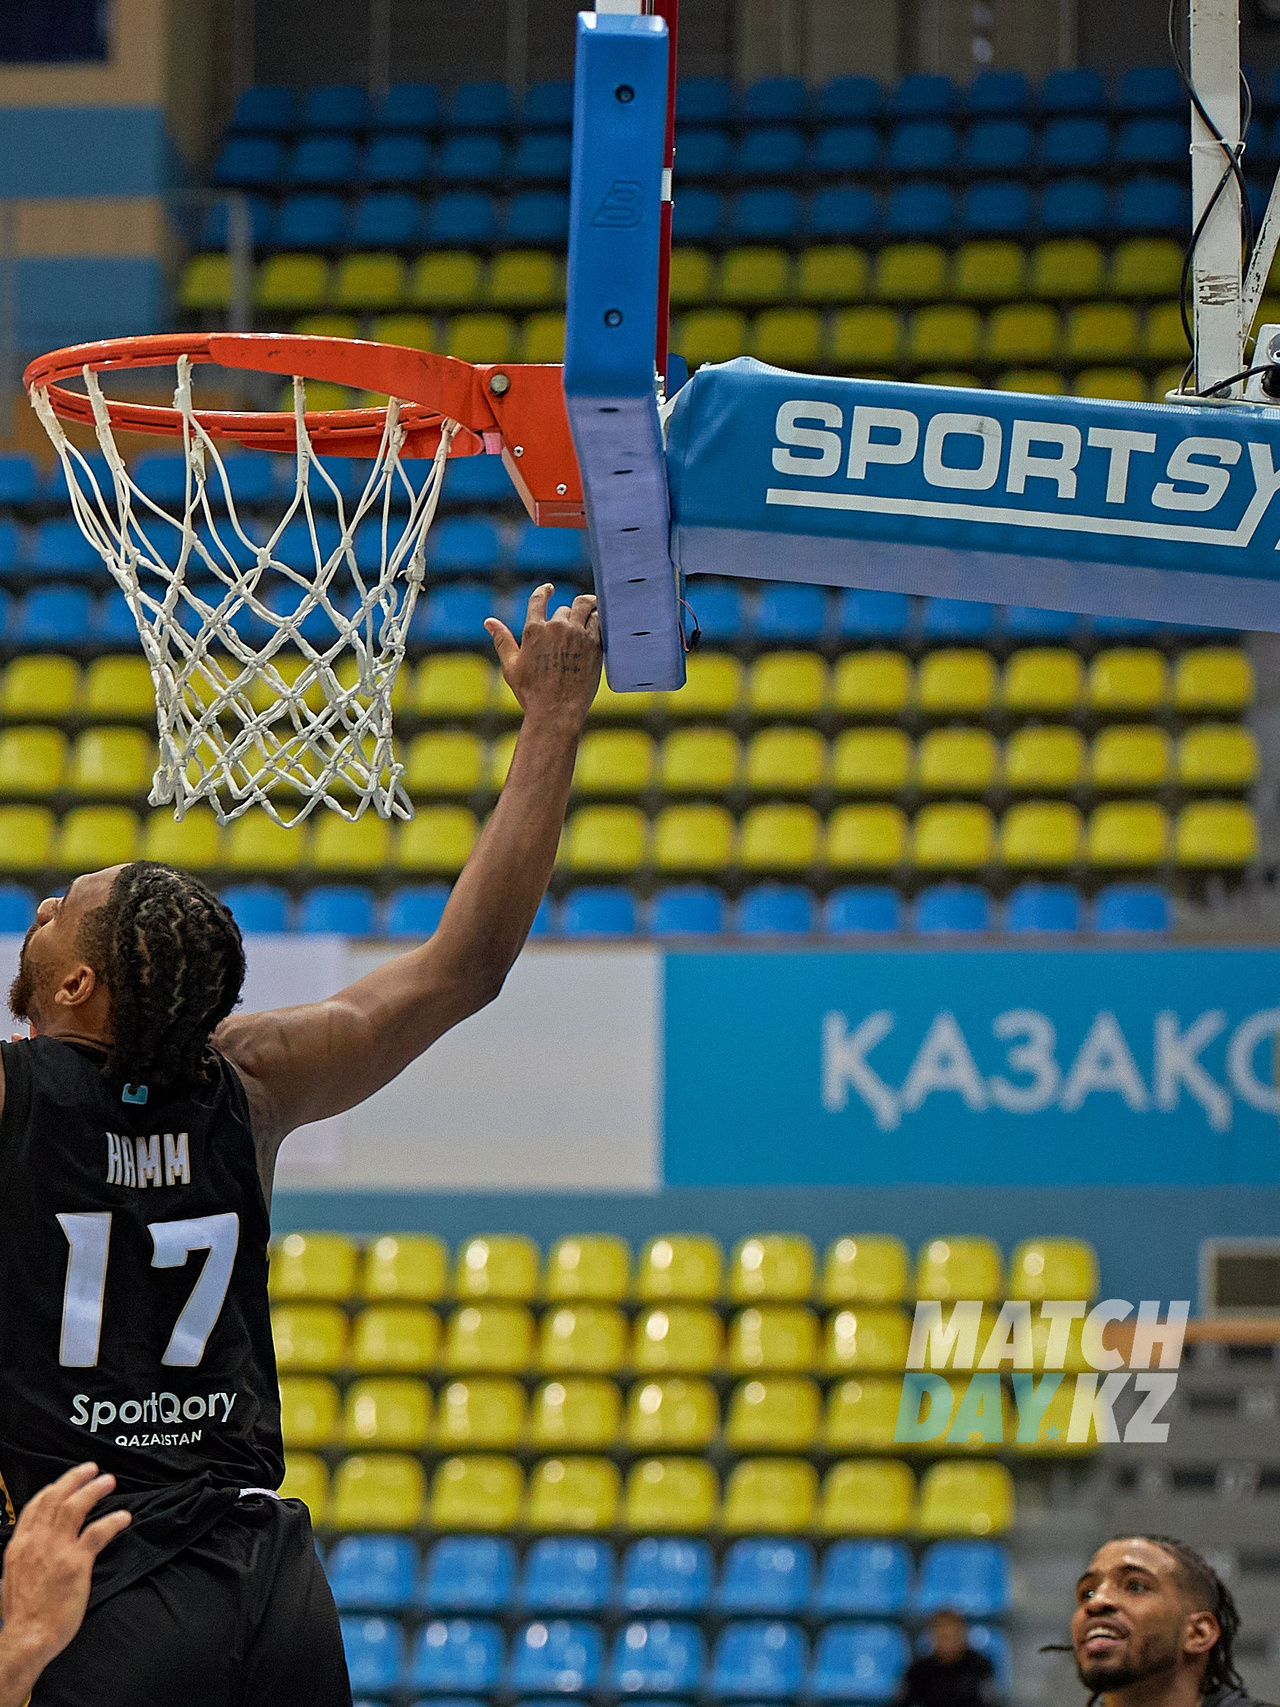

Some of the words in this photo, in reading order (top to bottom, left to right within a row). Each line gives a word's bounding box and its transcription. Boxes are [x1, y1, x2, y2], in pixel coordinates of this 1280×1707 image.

[106, 1132, 190, 1188] HAMM
[55, 1211, 240, 1367] 17
[69, 1391, 238, 1433] SportQory
